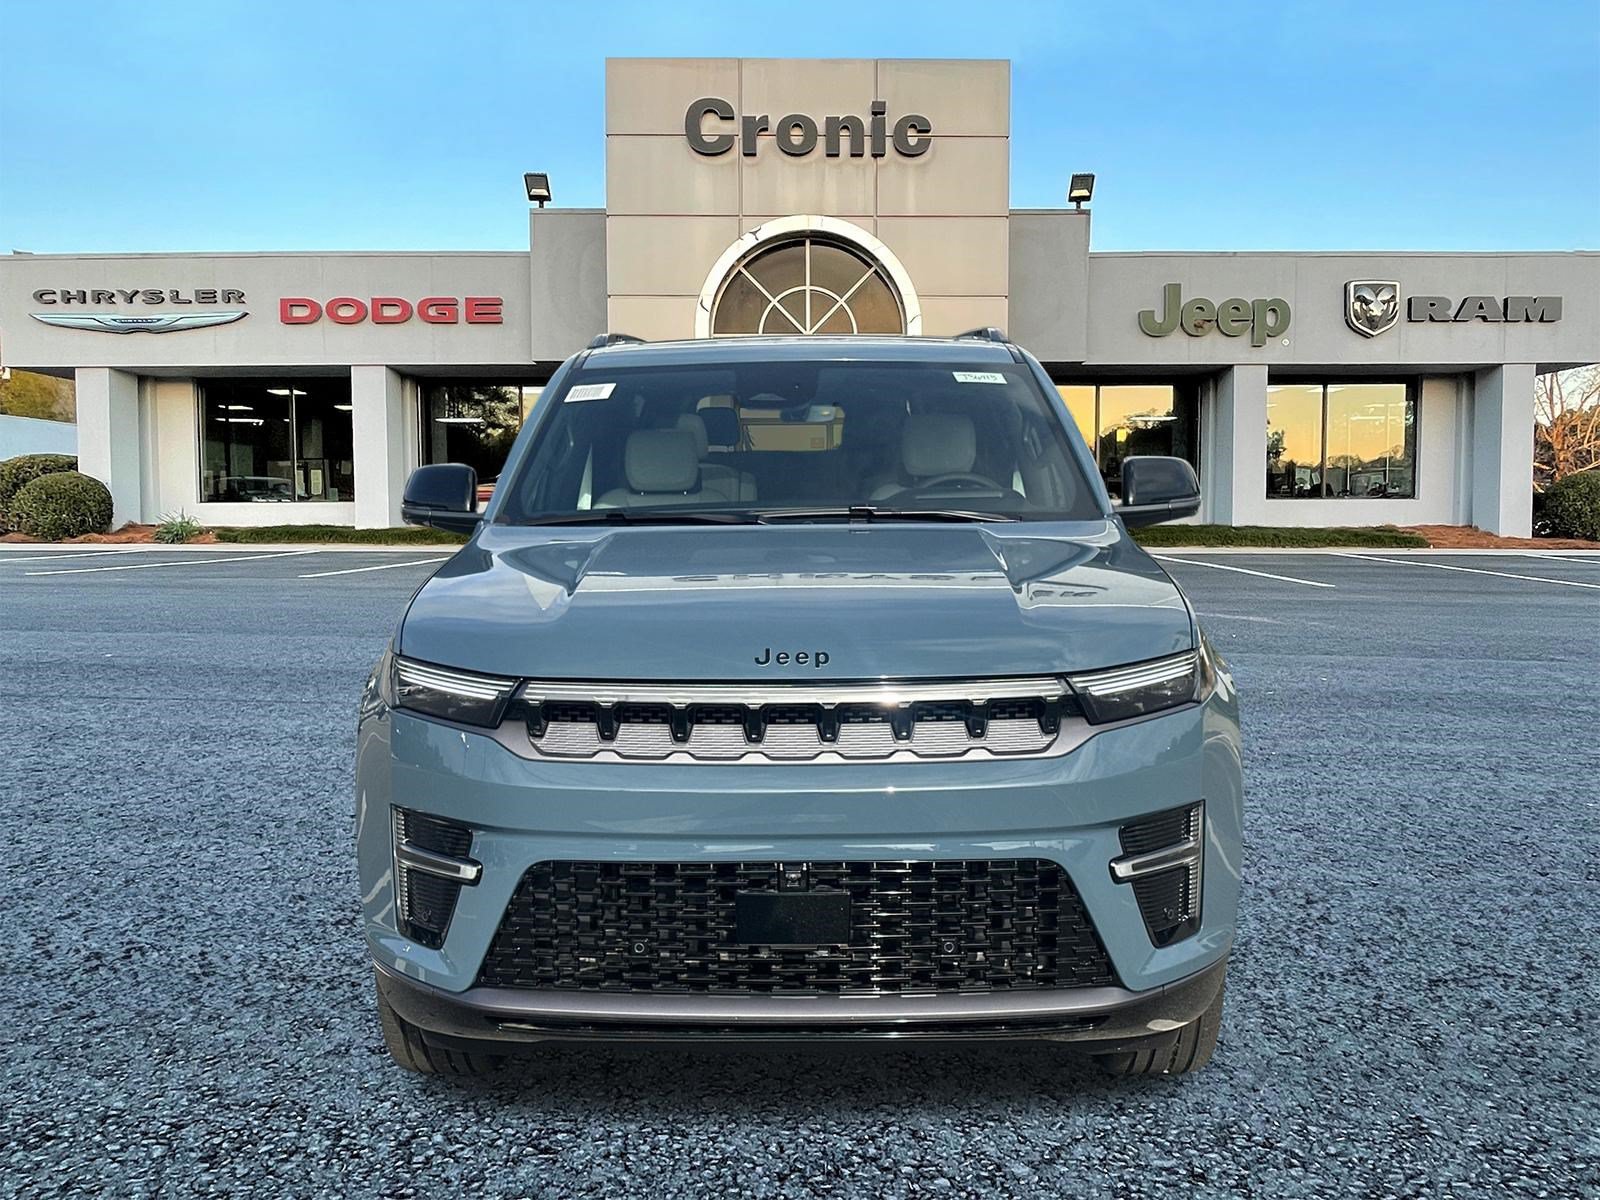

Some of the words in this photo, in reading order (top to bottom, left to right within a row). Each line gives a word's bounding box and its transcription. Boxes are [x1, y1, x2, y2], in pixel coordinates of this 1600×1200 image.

[685, 97, 932, 157] Cronic
[32, 289, 248, 305] CHRYSLER
[279, 297, 503, 324] DODGE
[1407, 296, 1563, 323] RAM
[1138, 283, 1291, 347] Jeep
[754, 648, 830, 668] Jeep
